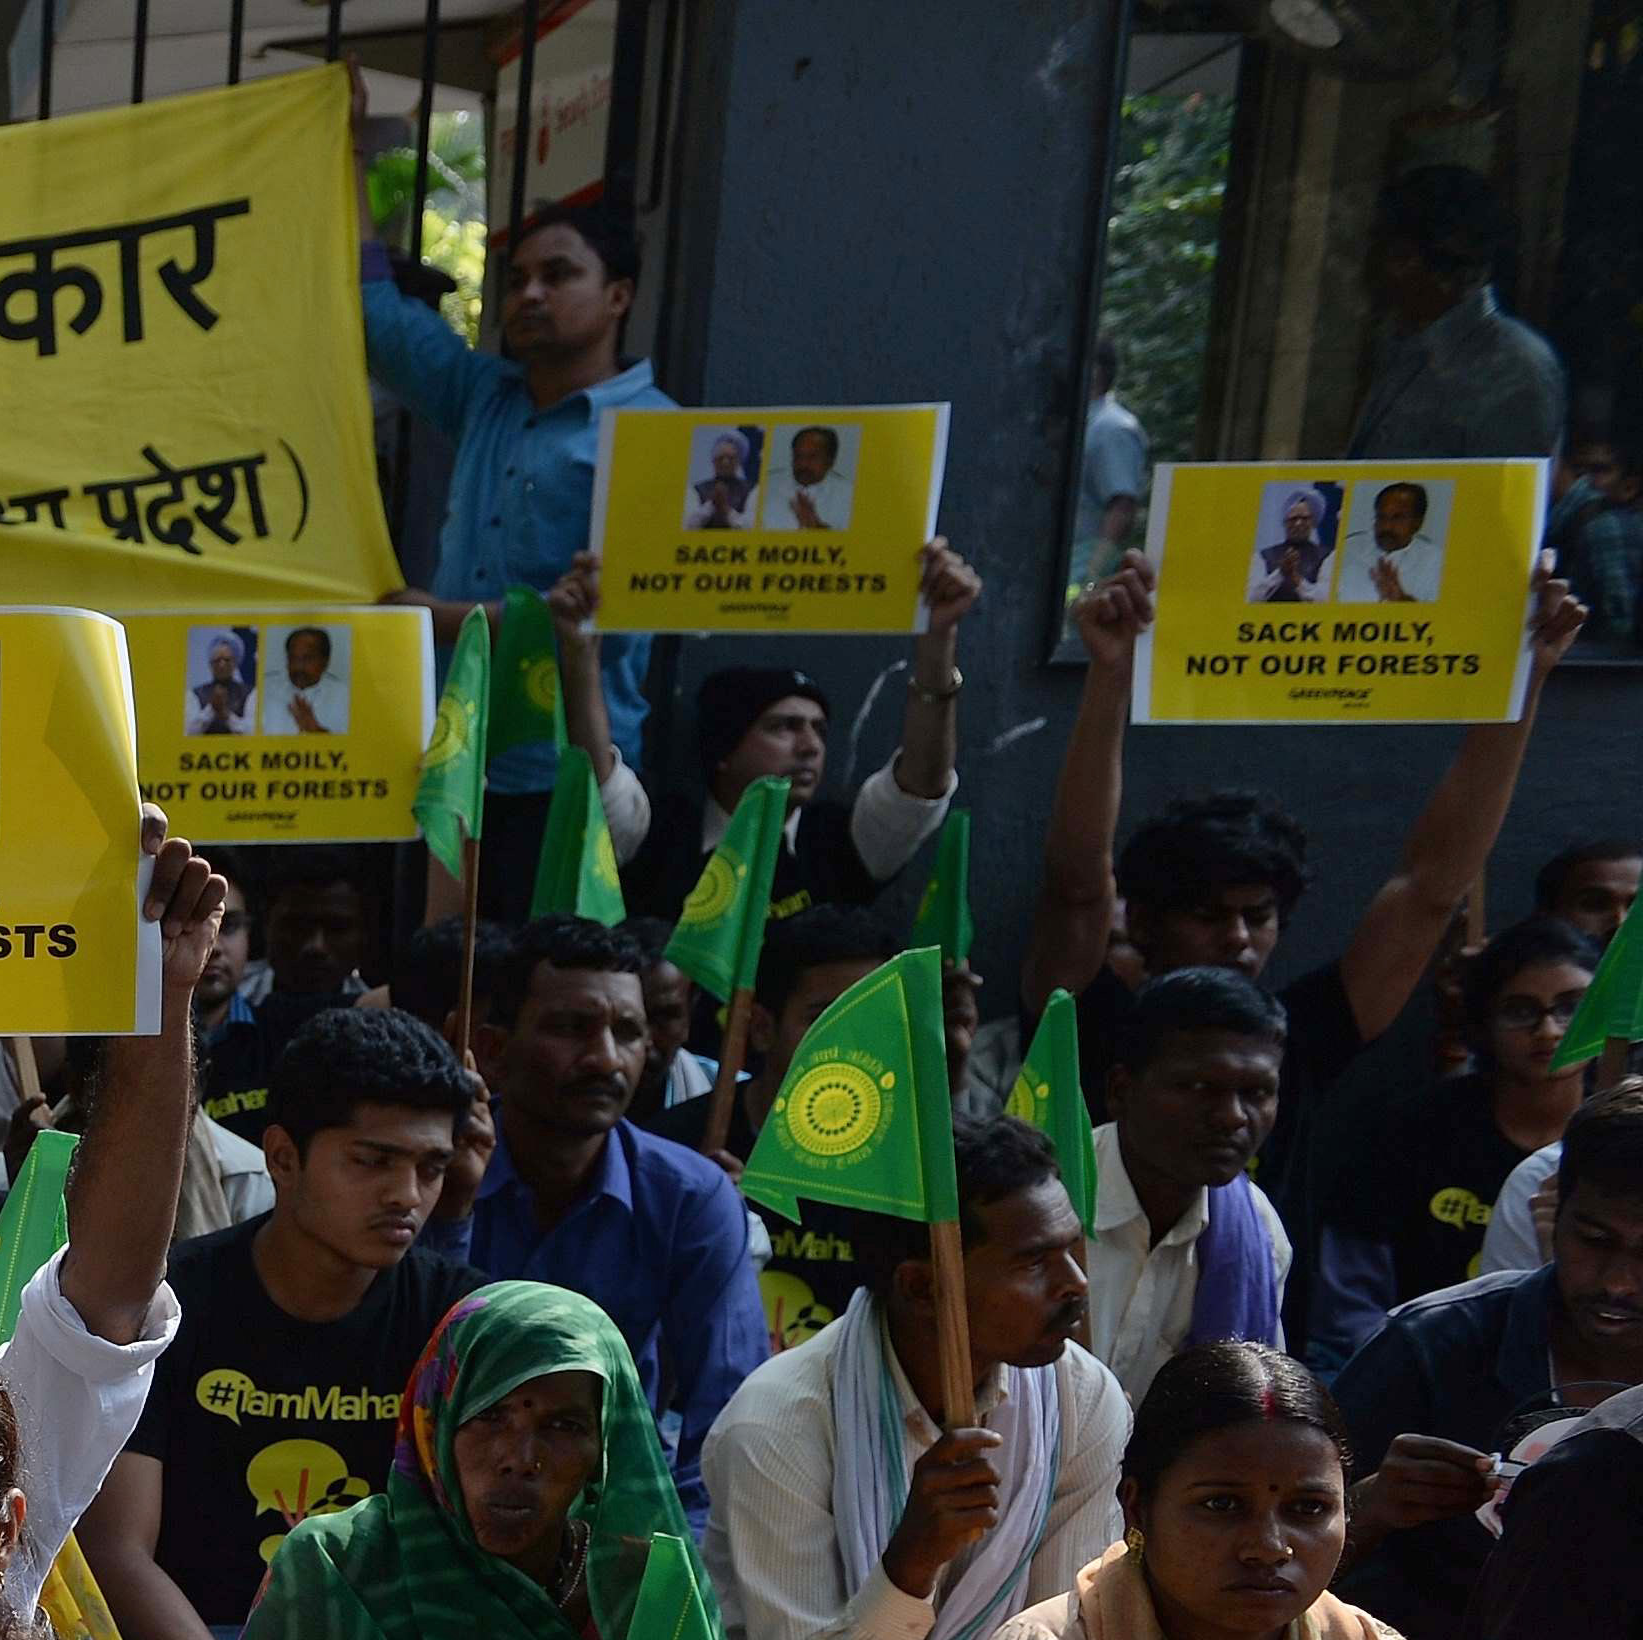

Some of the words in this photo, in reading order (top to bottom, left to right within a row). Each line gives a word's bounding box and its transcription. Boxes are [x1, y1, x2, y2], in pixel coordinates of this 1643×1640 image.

[675, 545, 748, 564] SACK
[757, 545, 848, 568] MOILY,
[629, 574, 686, 593] NOT
[695, 573, 753, 593] OUR
[762, 573, 888, 593] FORESTS
[1236, 621, 1321, 644] SACK
[1332, 621, 1435, 647] MOILY,
[1185, 655, 1249, 676] NOT
[1260, 655, 1326, 676] OUR
[1337, 654, 1482, 676] FORESTS
[179, 751, 251, 772] SACK
[260, 751, 349, 772] MOILY,
[139, 781, 191, 801] NOT
[199, 780, 258, 800] OUR
[267, 778, 390, 800] FORESTS
[202, 1377, 402, 1421] #iamMaha
